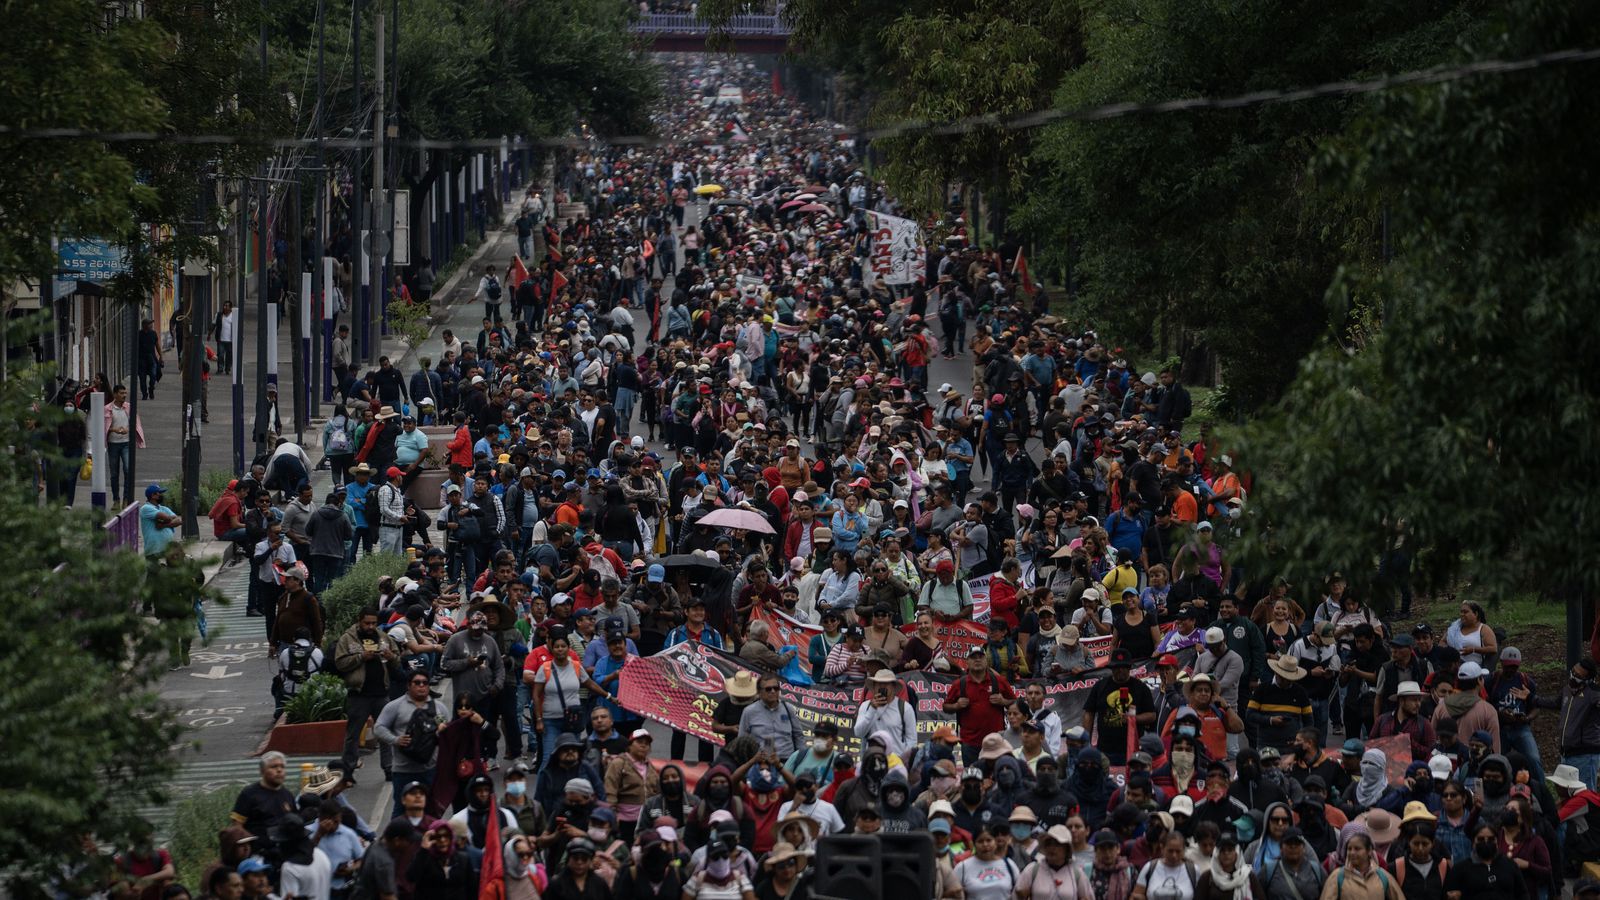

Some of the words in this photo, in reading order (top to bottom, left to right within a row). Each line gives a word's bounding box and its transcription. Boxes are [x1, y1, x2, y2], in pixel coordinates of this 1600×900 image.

[72, 259, 86, 268] 55
[89, 259, 118, 268] 2648
[937, 627, 948, 635] DE
[951, 628, 967, 637] LOS
[946, 640, 962, 649] LOS
[802, 695, 857, 715] EDUC
